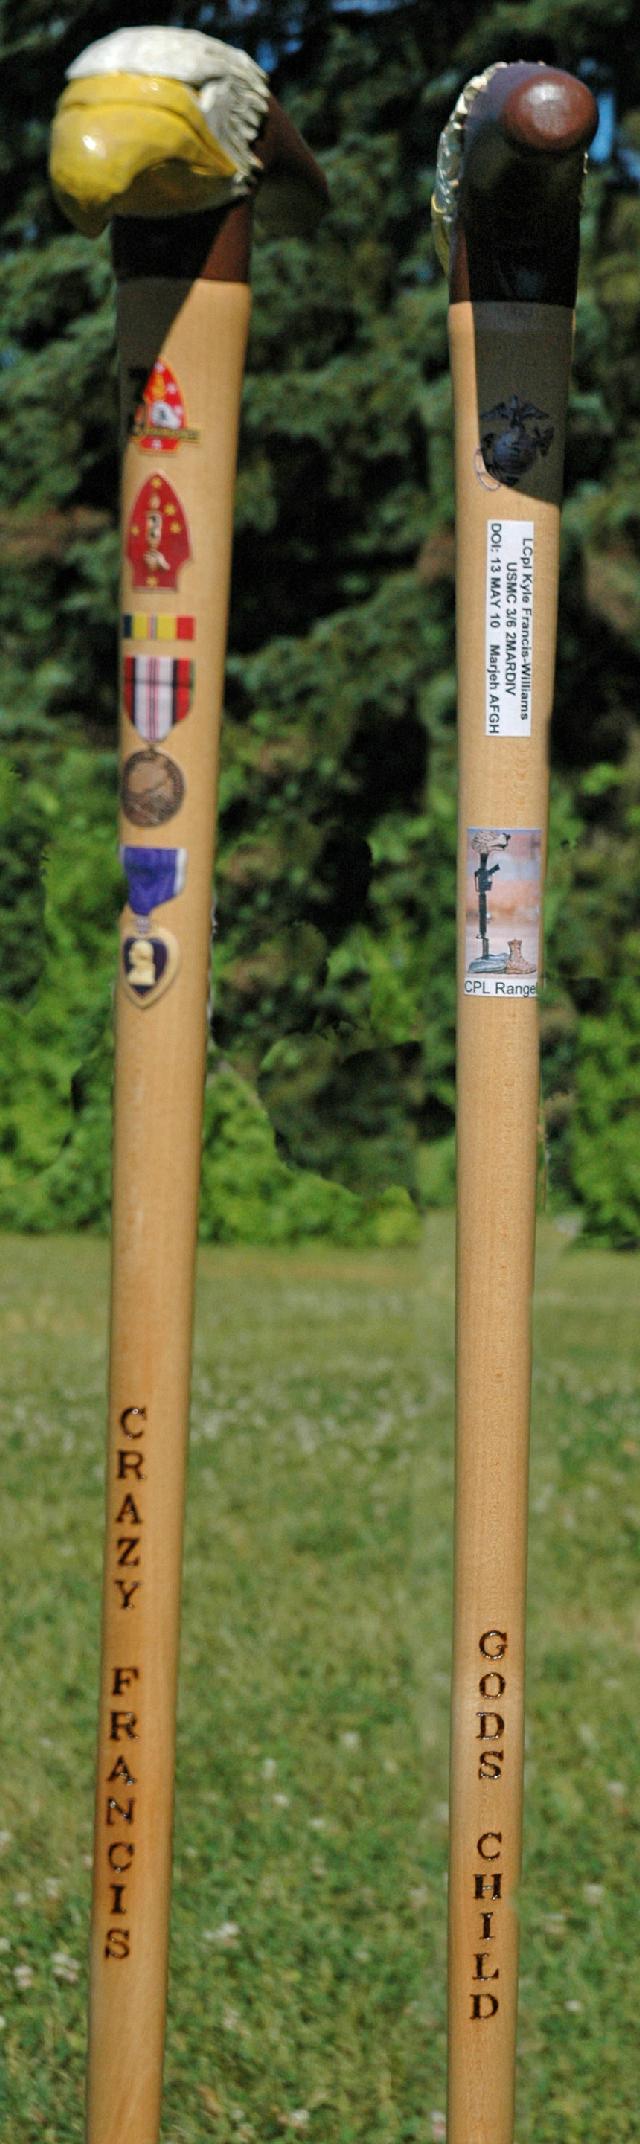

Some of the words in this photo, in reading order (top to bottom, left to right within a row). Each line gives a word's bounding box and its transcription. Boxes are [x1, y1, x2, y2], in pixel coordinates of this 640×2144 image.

[491, 523, 501, 551] DOI:
[521, 538, 533, 568] LCpl
[491, 558, 501, 572] 13
[506, 562, 516, 603] USMC
[491, 577, 501, 608] MAY
[520, 574, 532, 603] Kyle
[490, 613, 500, 628] 10
[487, 645, 500, 689] Marjeh
[505, 632, 516, 696] 2MARDIV
[521, 609, 532, 720] Francis-Williams
[489, 694, 499, 734] AFGH
[465, 980, 490, 993] CPL
[114, 1405, 147, 1610] CRAZY
[475, 1629, 508, 1780] GODS
[104, 1667, 139, 1960] FRANCIS
[469, 1832, 502, 2020] CHILD
